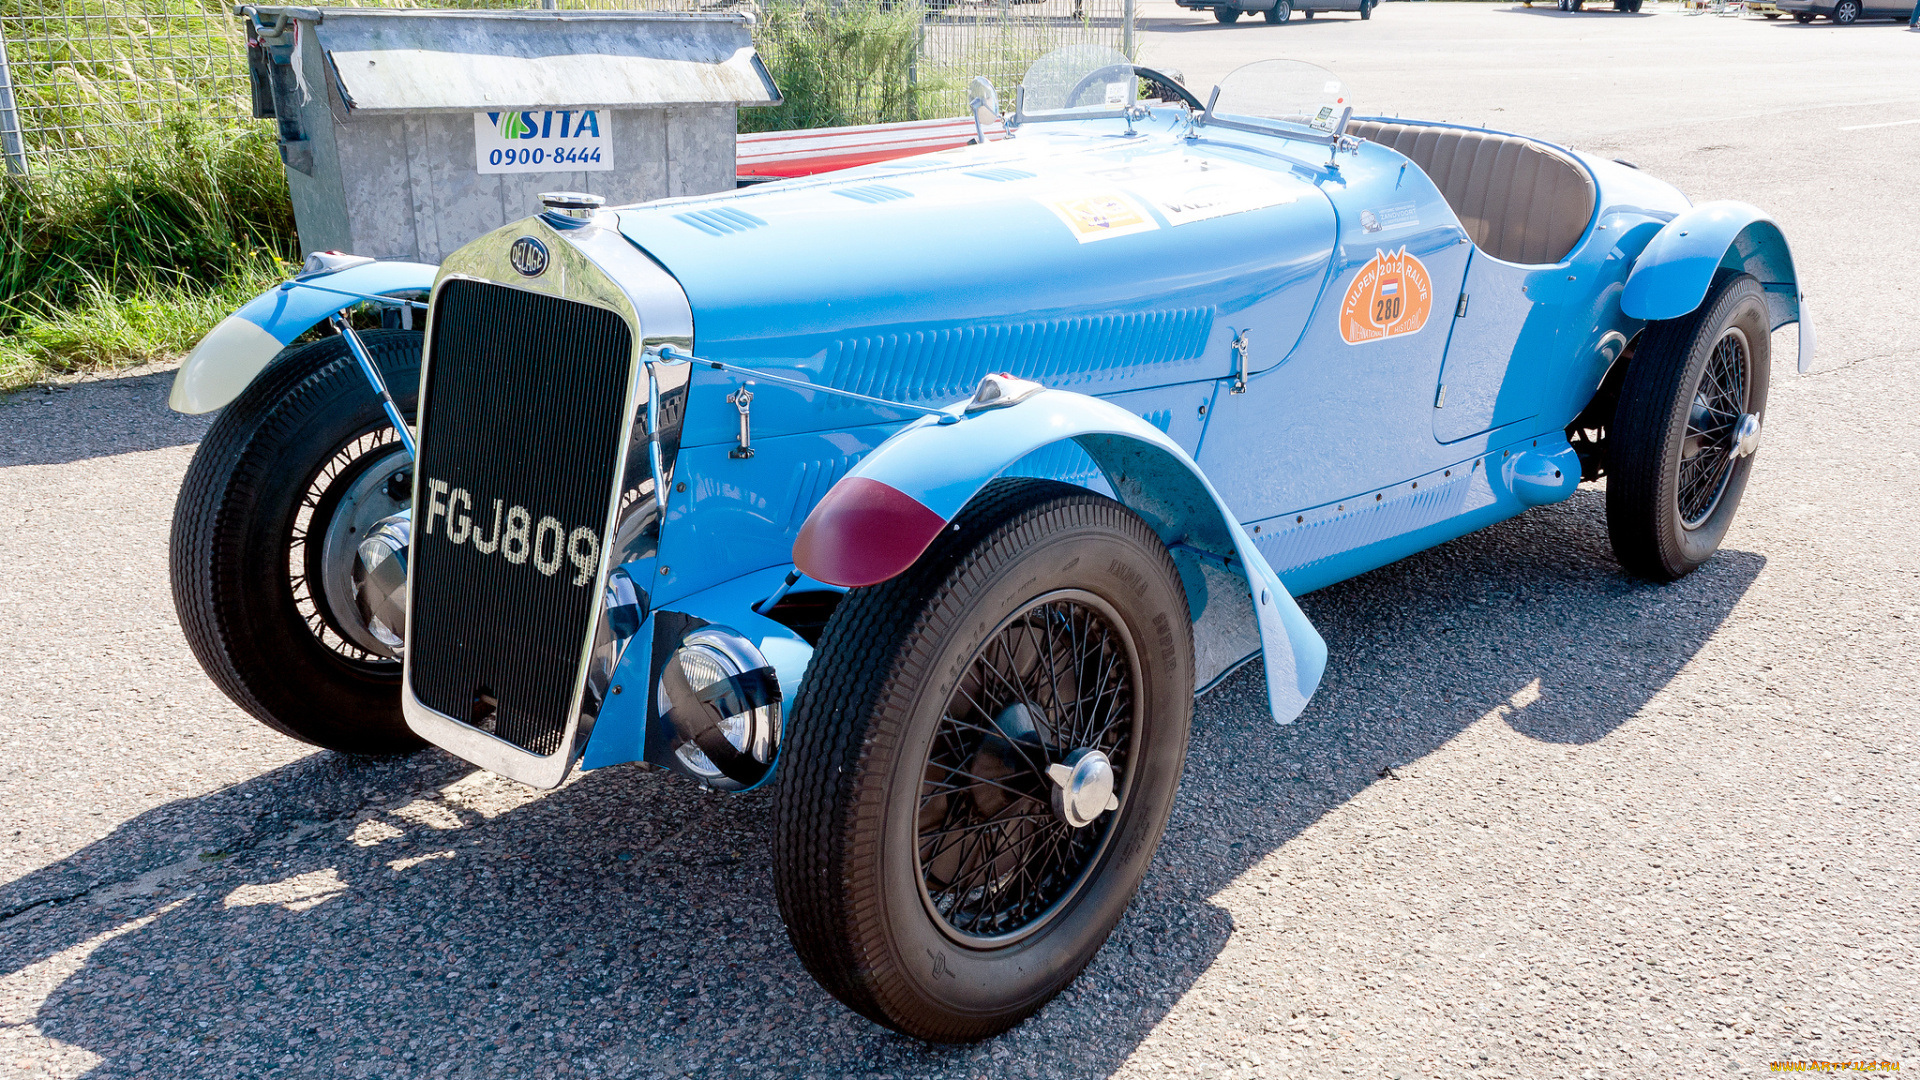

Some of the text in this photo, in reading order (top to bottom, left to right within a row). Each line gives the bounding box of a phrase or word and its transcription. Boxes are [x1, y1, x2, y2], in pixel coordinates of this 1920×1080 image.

[519, 110, 601, 139] SITA
[489, 147, 601, 166] 0900-8444
[511, 242, 544, 272] DELAGE
[1346, 261, 1428, 316] TULPEN 2012 RALLYE
[1376, 297, 1400, 321] 280
[1348, 307, 1422, 341] INTERNATIONAL HISTORIC
